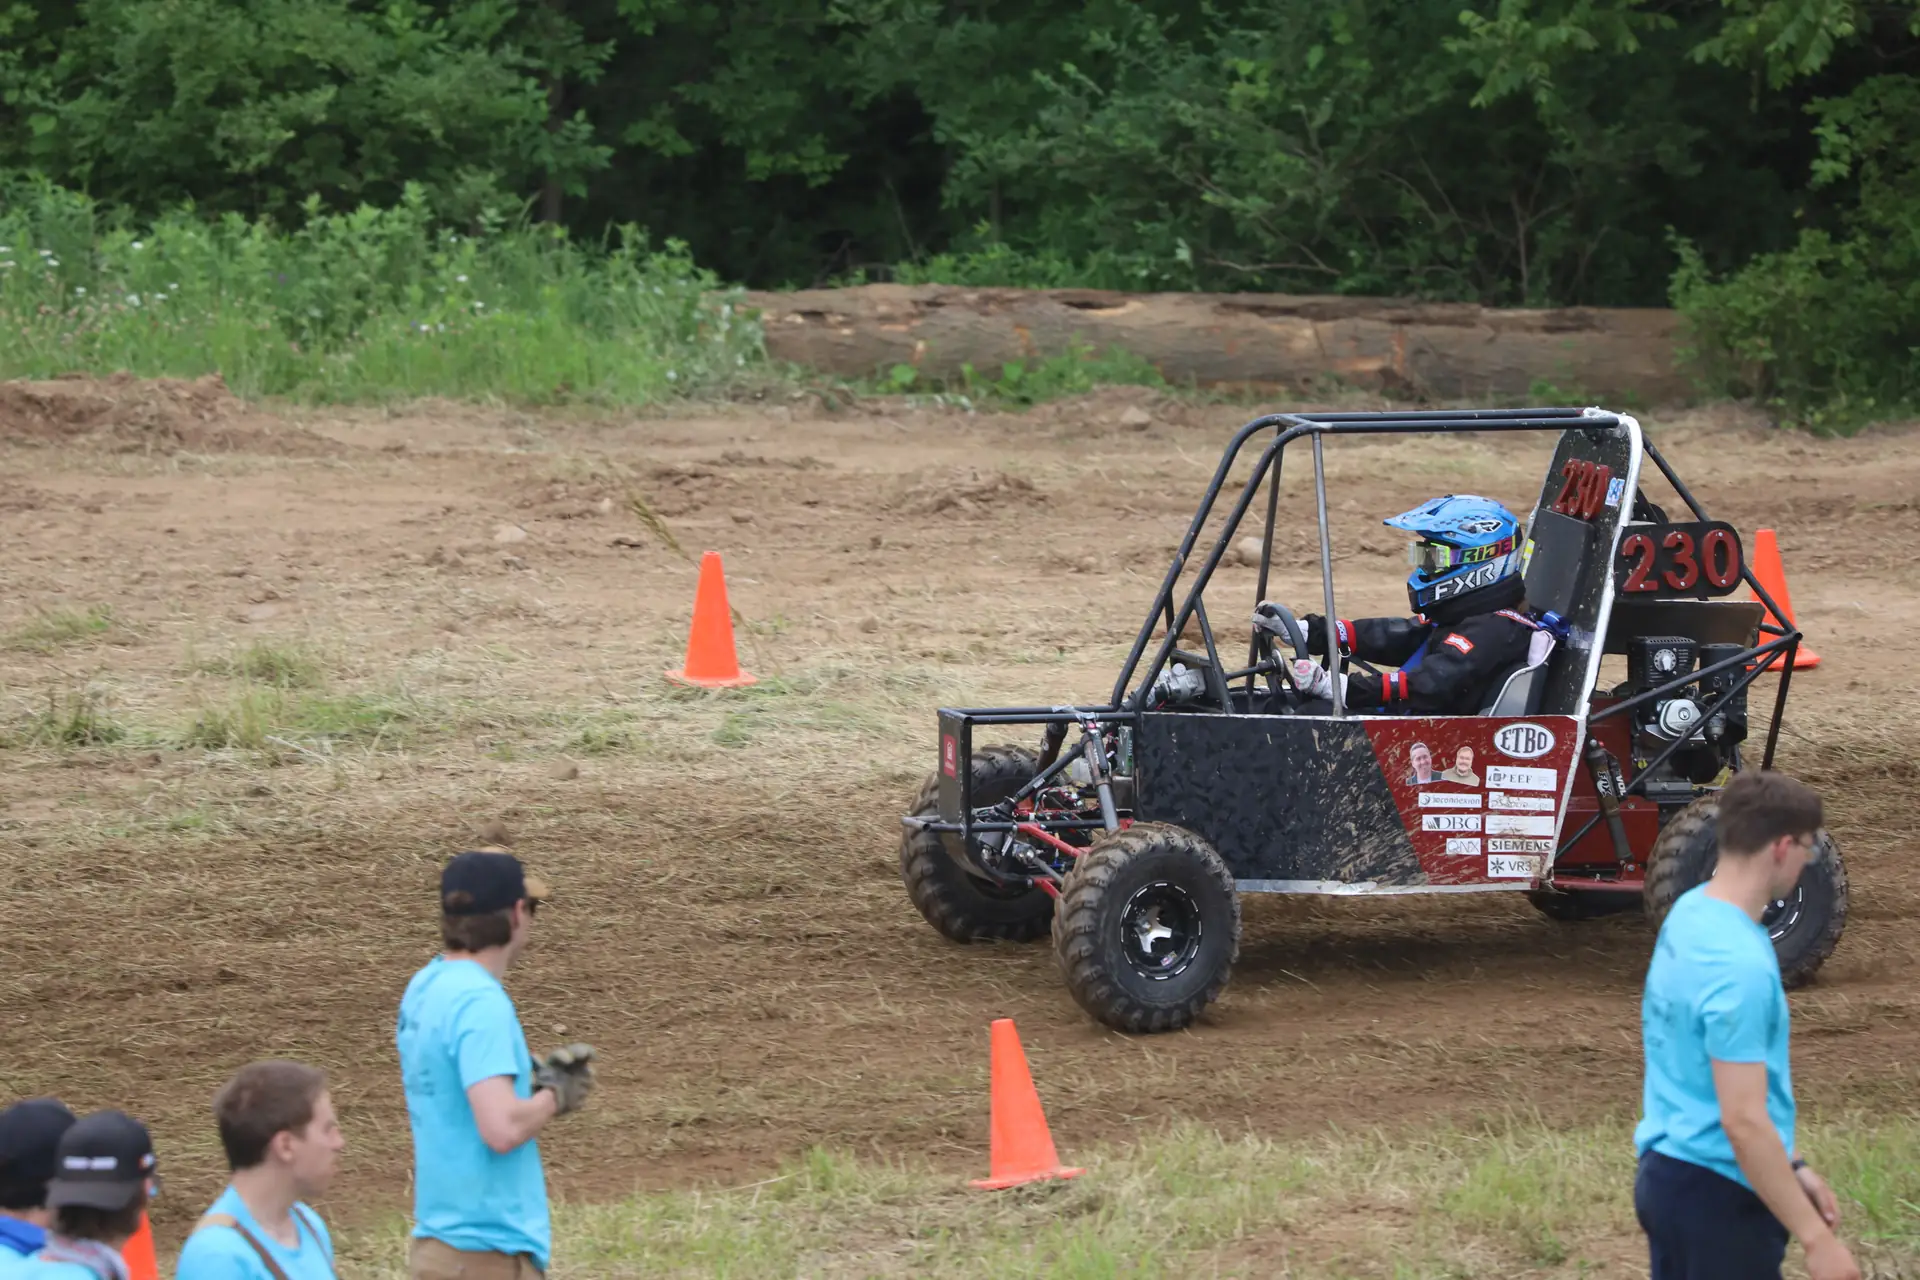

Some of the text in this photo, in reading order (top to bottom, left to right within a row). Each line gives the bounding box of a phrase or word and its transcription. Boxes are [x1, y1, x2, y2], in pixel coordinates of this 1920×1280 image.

[1552, 457, 1609, 520] 230
[1460, 537, 1513, 563] RIDE
[1621, 529, 1739, 592] 230
[1434, 562, 1495, 601] FXR
[1500, 727, 1548, 754] ETBO
[1440, 816, 1480, 831] DBG
[1491, 840, 1551, 852] SIEMENS
